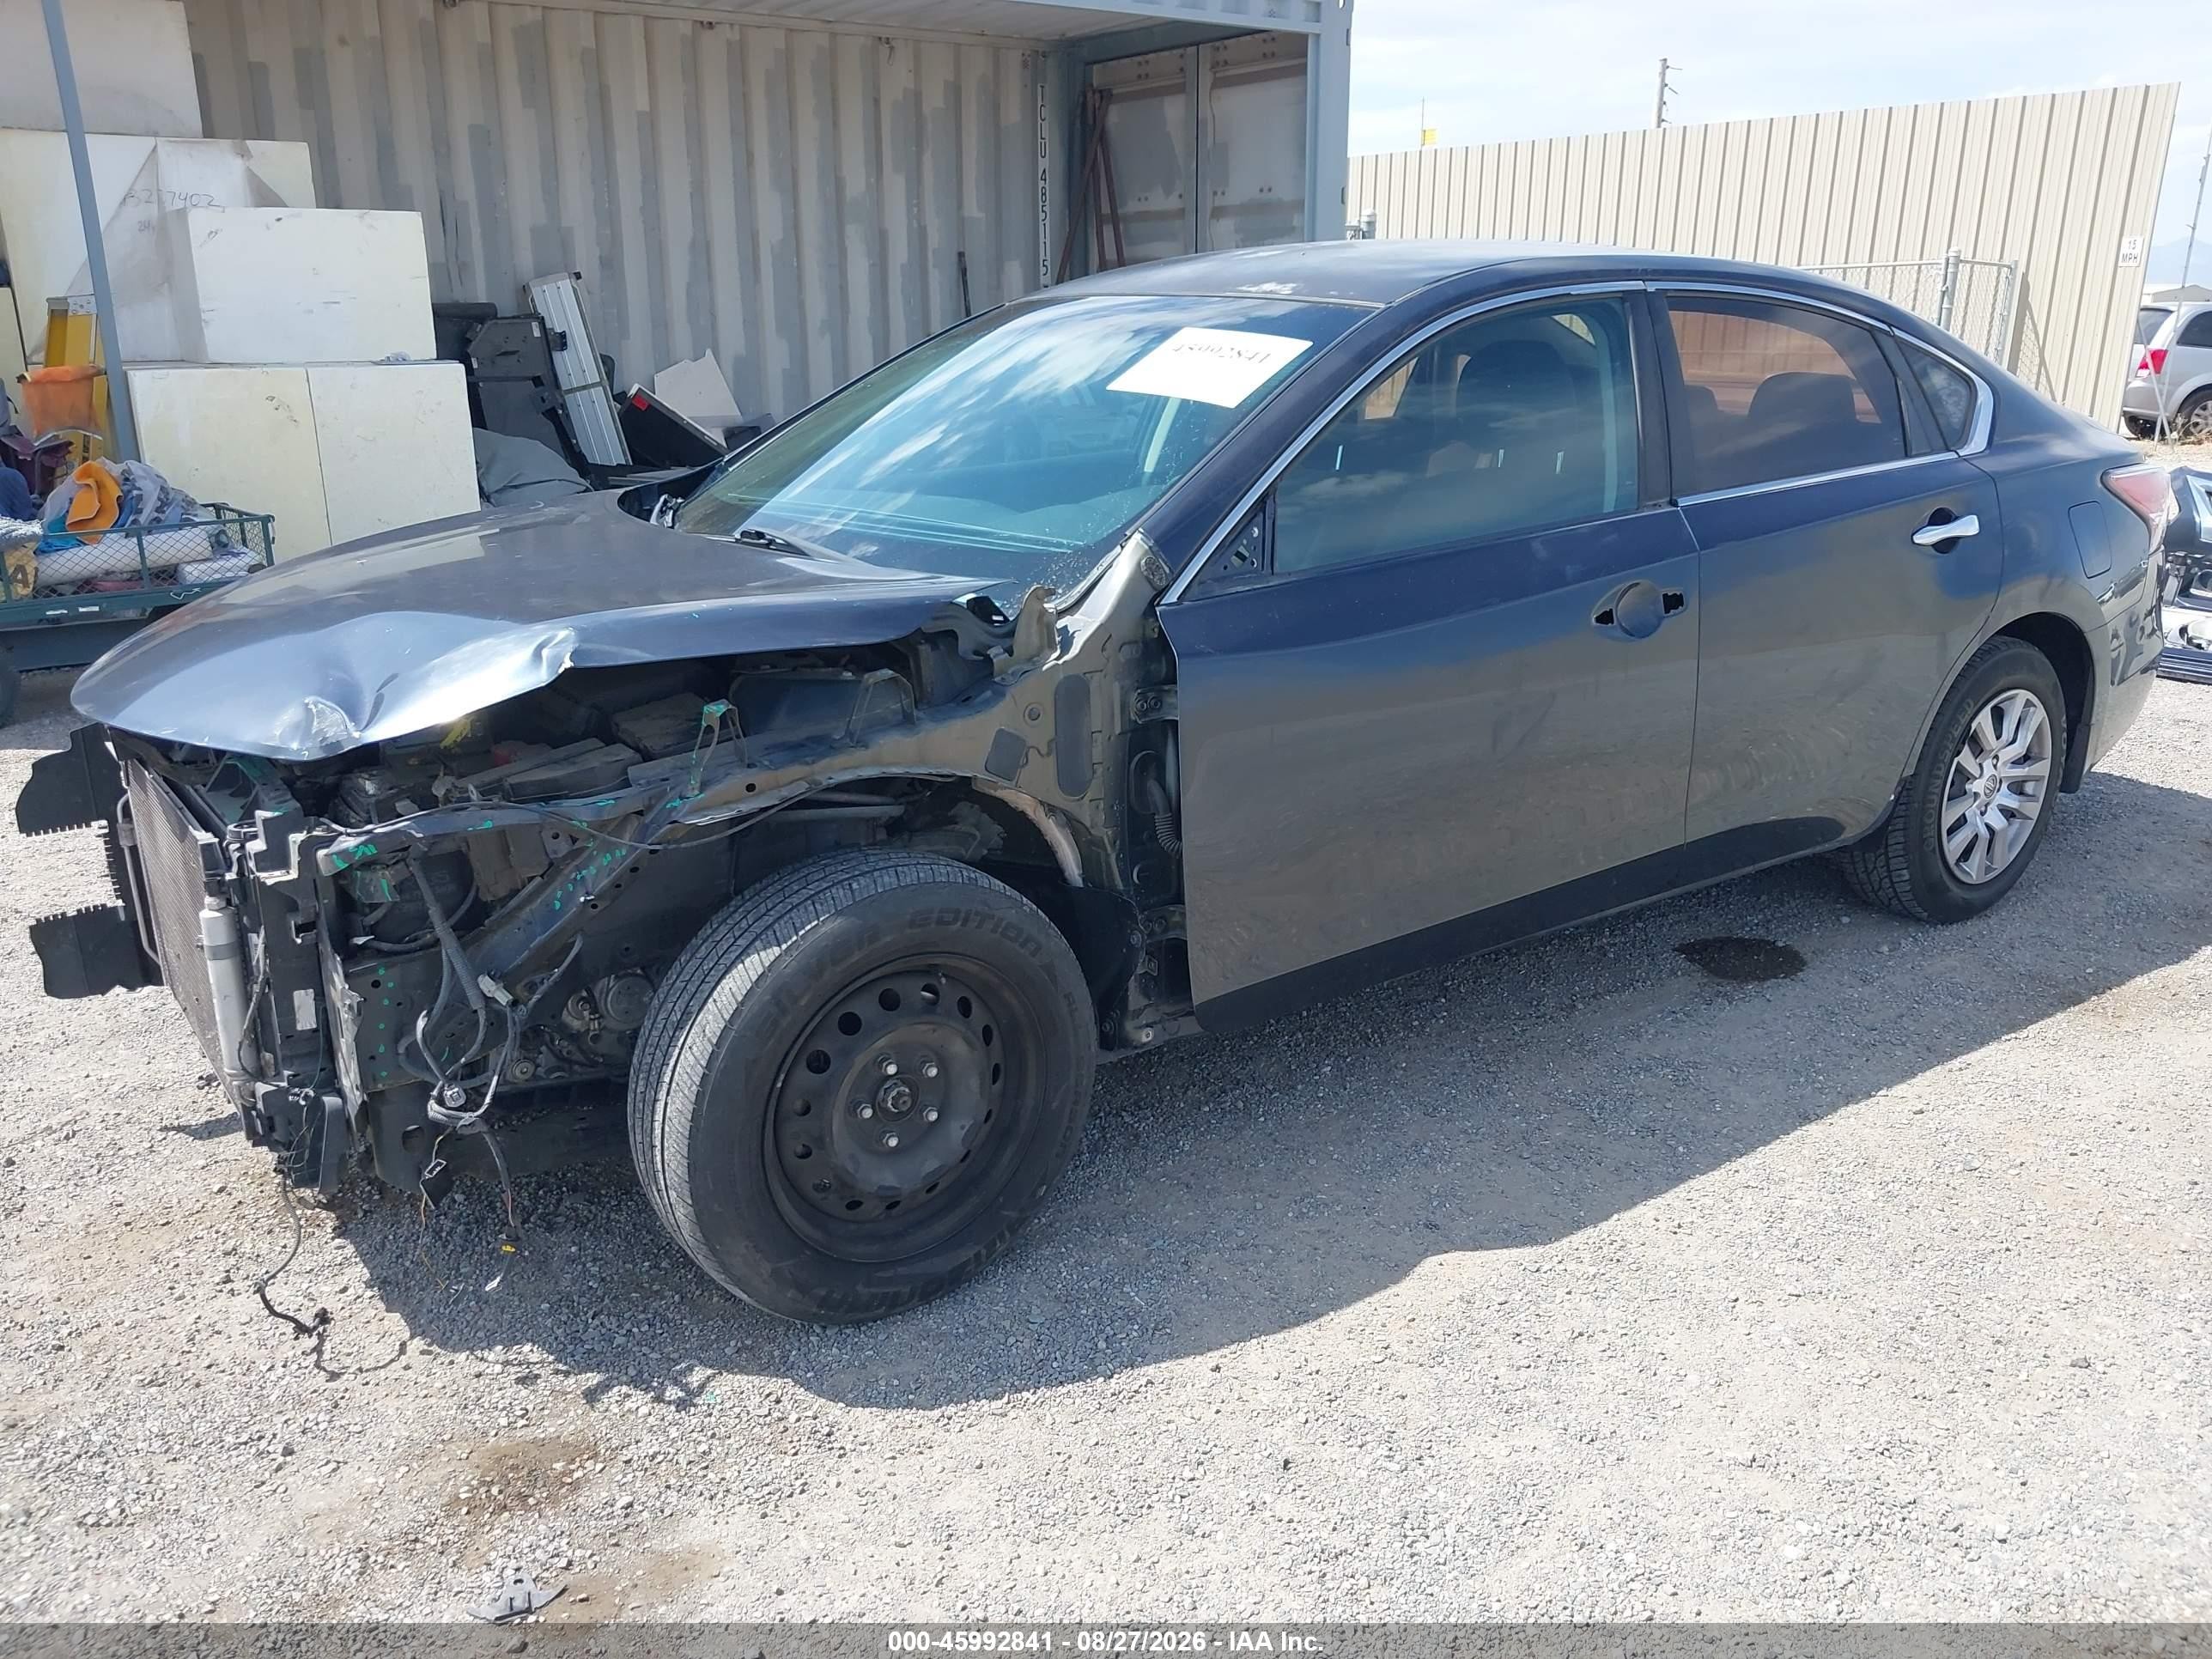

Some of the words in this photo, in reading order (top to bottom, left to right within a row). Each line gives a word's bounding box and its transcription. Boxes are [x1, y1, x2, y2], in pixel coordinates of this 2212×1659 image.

[1038, 84, 1047, 159] TCLU
[1040, 167, 1048, 276] 485115
[2129, 239, 2137, 250] 15
[2121, 252, 2139, 264] MPH
[907, 907, 1043, 958] EDITION
